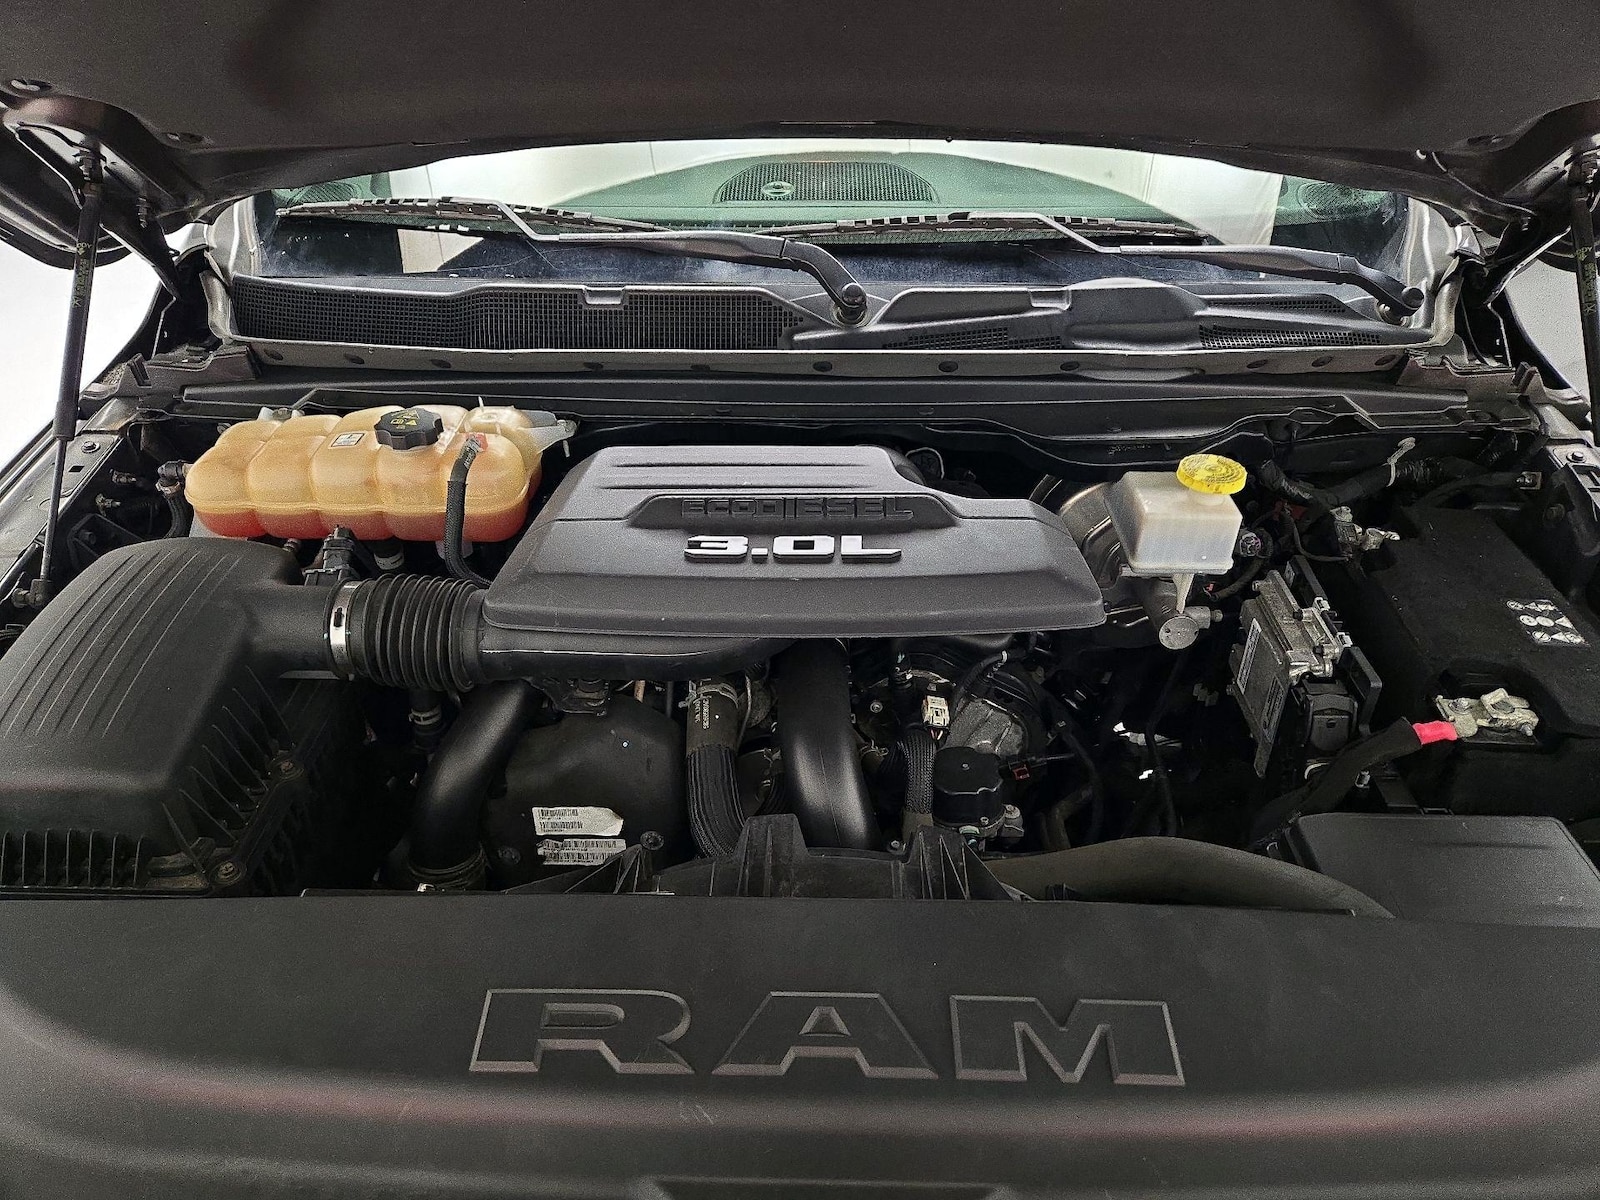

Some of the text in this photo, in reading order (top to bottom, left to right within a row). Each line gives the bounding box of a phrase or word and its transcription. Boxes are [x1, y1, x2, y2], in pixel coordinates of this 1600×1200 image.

[681, 496, 914, 519] ECODIESEL
[684, 534, 902, 562] 3.0L
[469, 988, 1186, 1086] RAM
